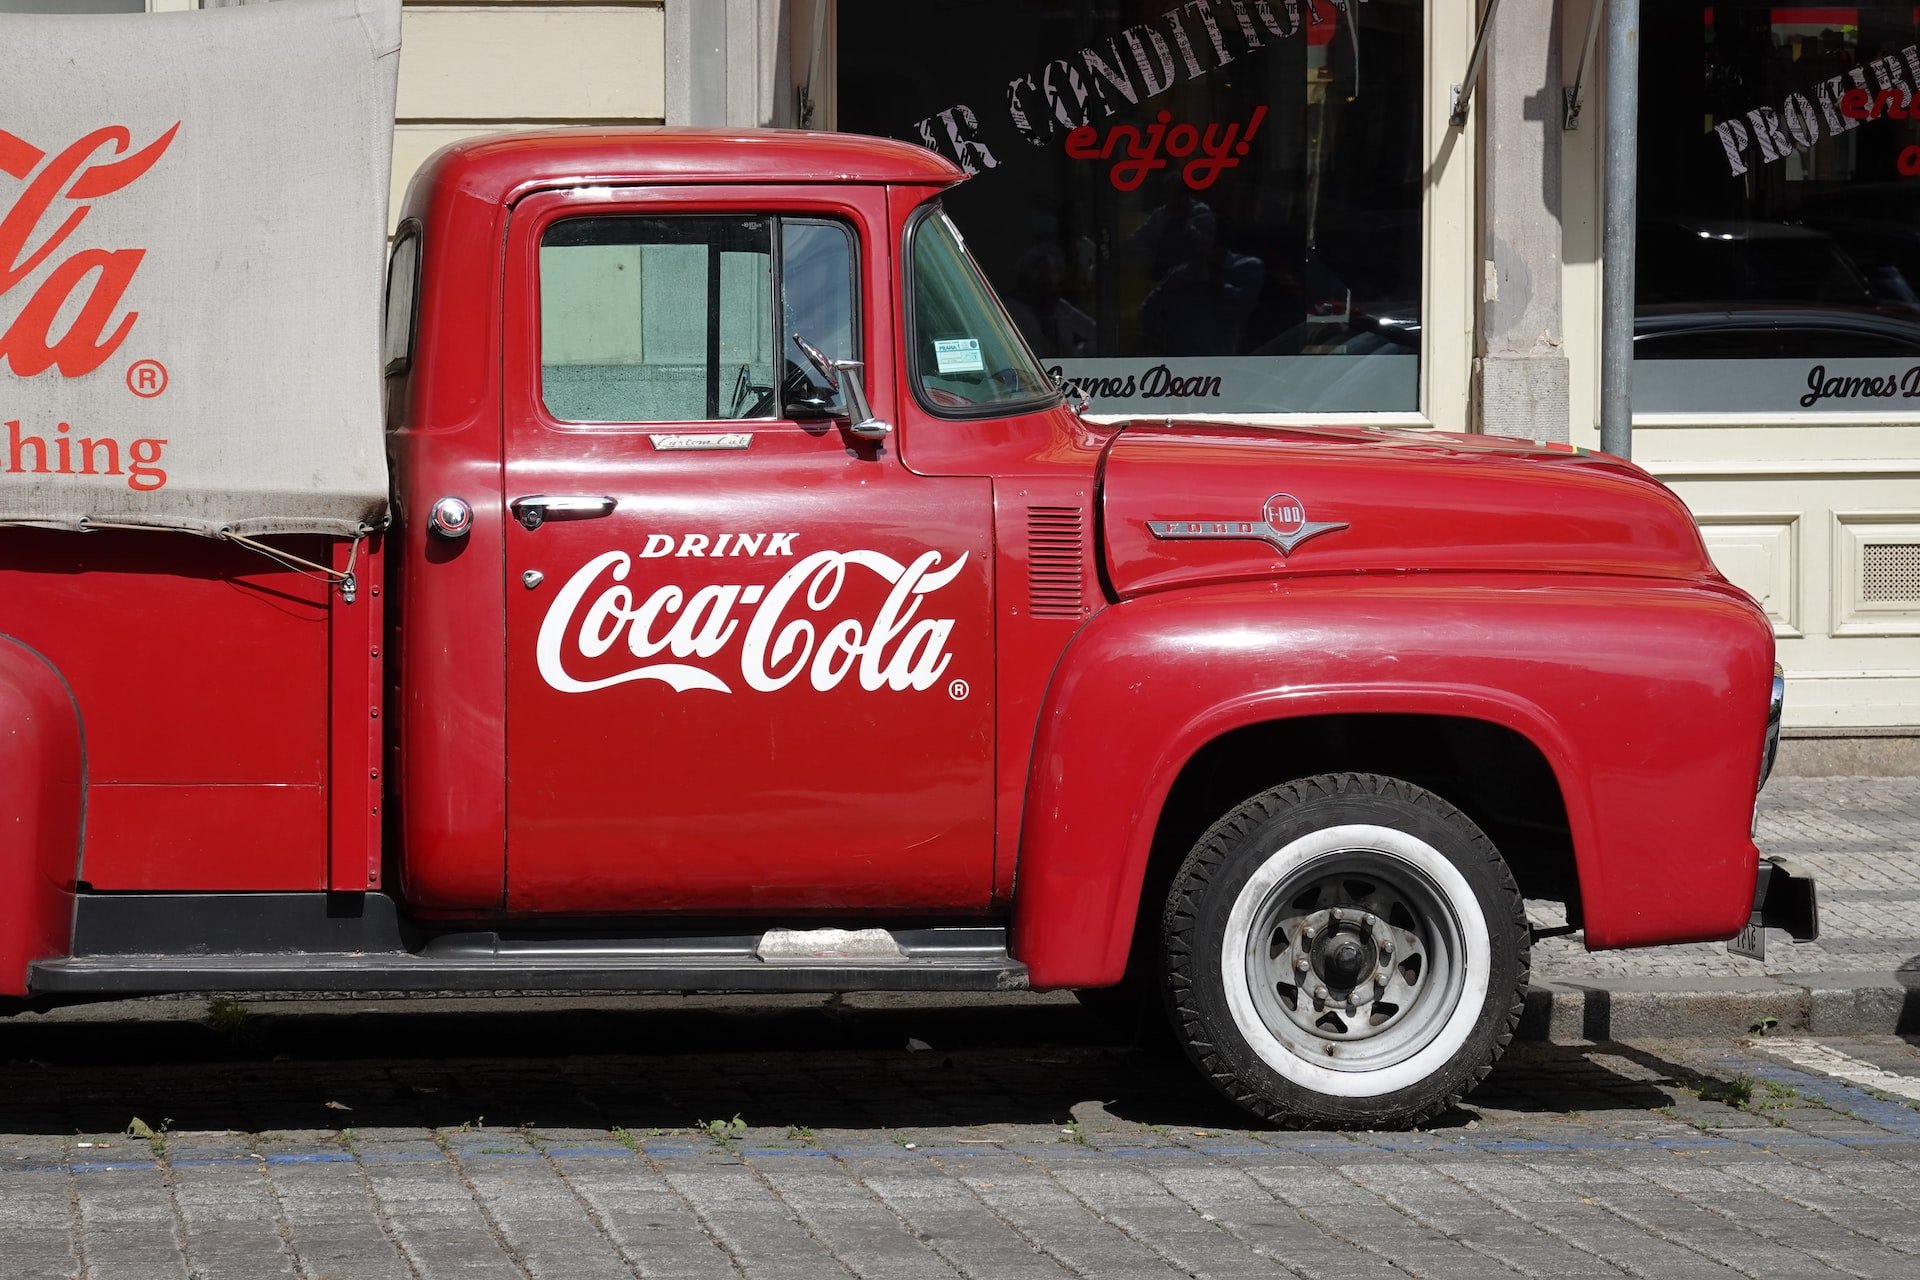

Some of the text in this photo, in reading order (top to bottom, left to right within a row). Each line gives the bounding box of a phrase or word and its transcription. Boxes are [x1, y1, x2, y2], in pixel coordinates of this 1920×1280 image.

[1065, 105, 1268, 192] enjoy!
[1139, 364, 1222, 398] Dean
[1800, 365, 1898, 408] James
[0, 420, 168, 492] hing
[1165, 522, 1254, 534] FORD
[1268, 505, 1300, 523] F-100
[639, 532, 800, 559] DRINK
[536, 549, 970, 694] Coca-Cola
